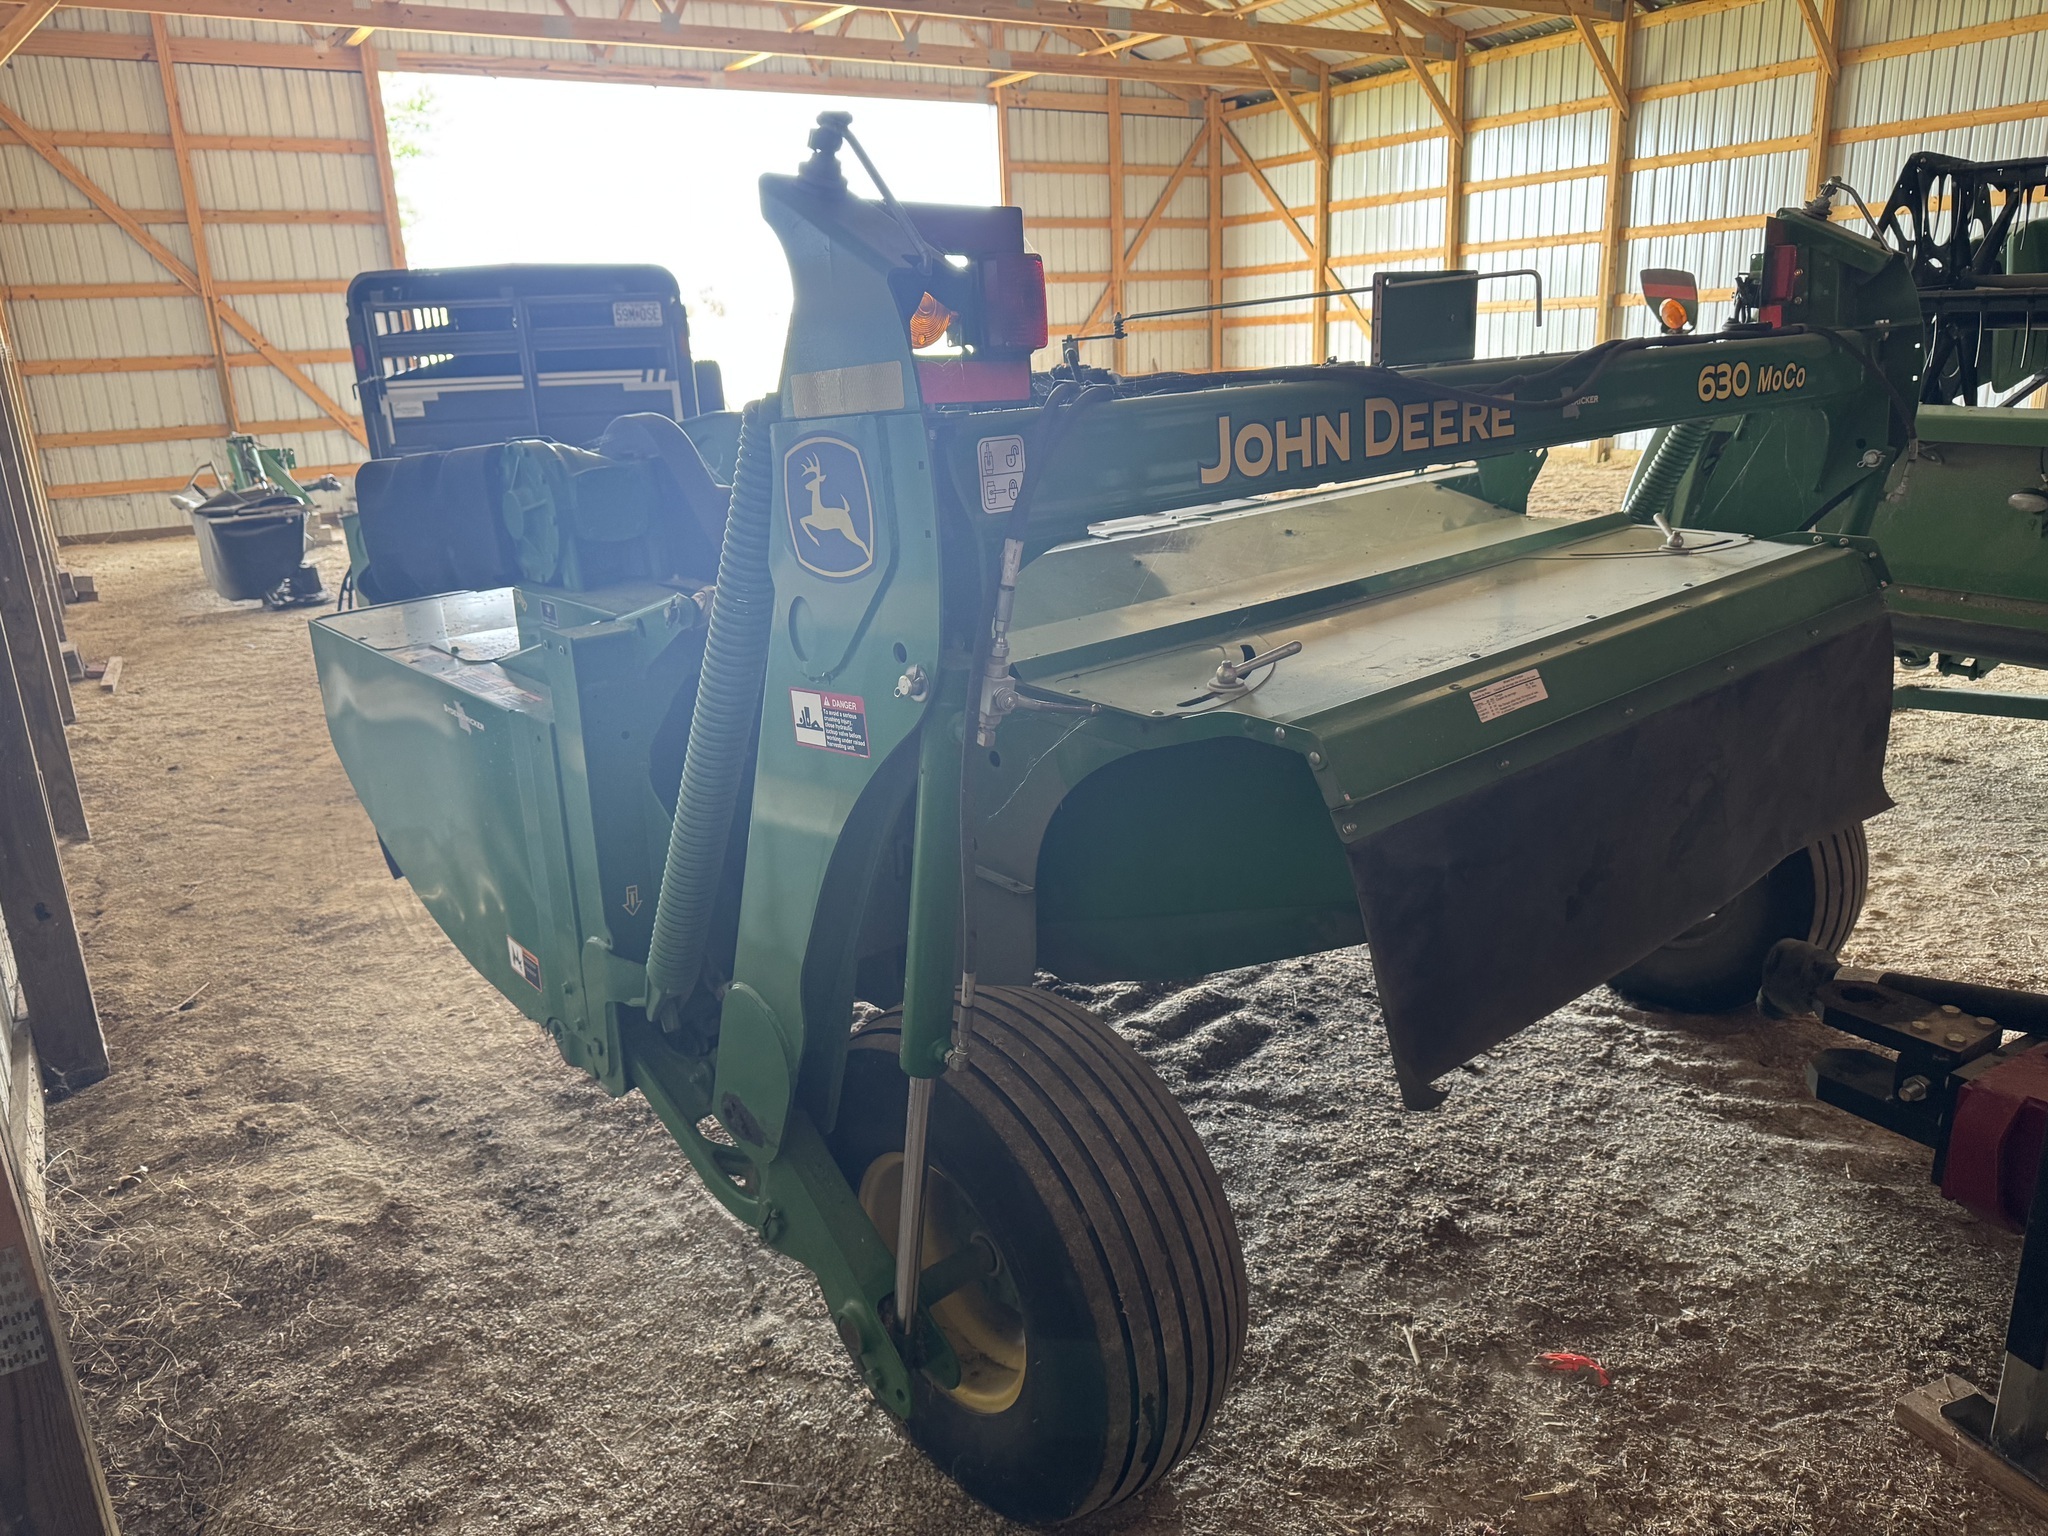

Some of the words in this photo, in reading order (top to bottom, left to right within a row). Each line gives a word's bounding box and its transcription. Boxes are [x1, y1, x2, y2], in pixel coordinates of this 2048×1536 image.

[1698, 361, 1751, 402] 630
[1757, 362, 1806, 393] MoCo
[1200, 411, 1351, 484] JOHN
[1365, 393, 1515, 458] DEERE
[832, 699, 857, 710] DANGER
[824, 716, 841, 724] crushing
[835, 724, 853, 732] hydraulic
[826, 735, 841, 744] working
[827, 740, 847, 751] harvesting
